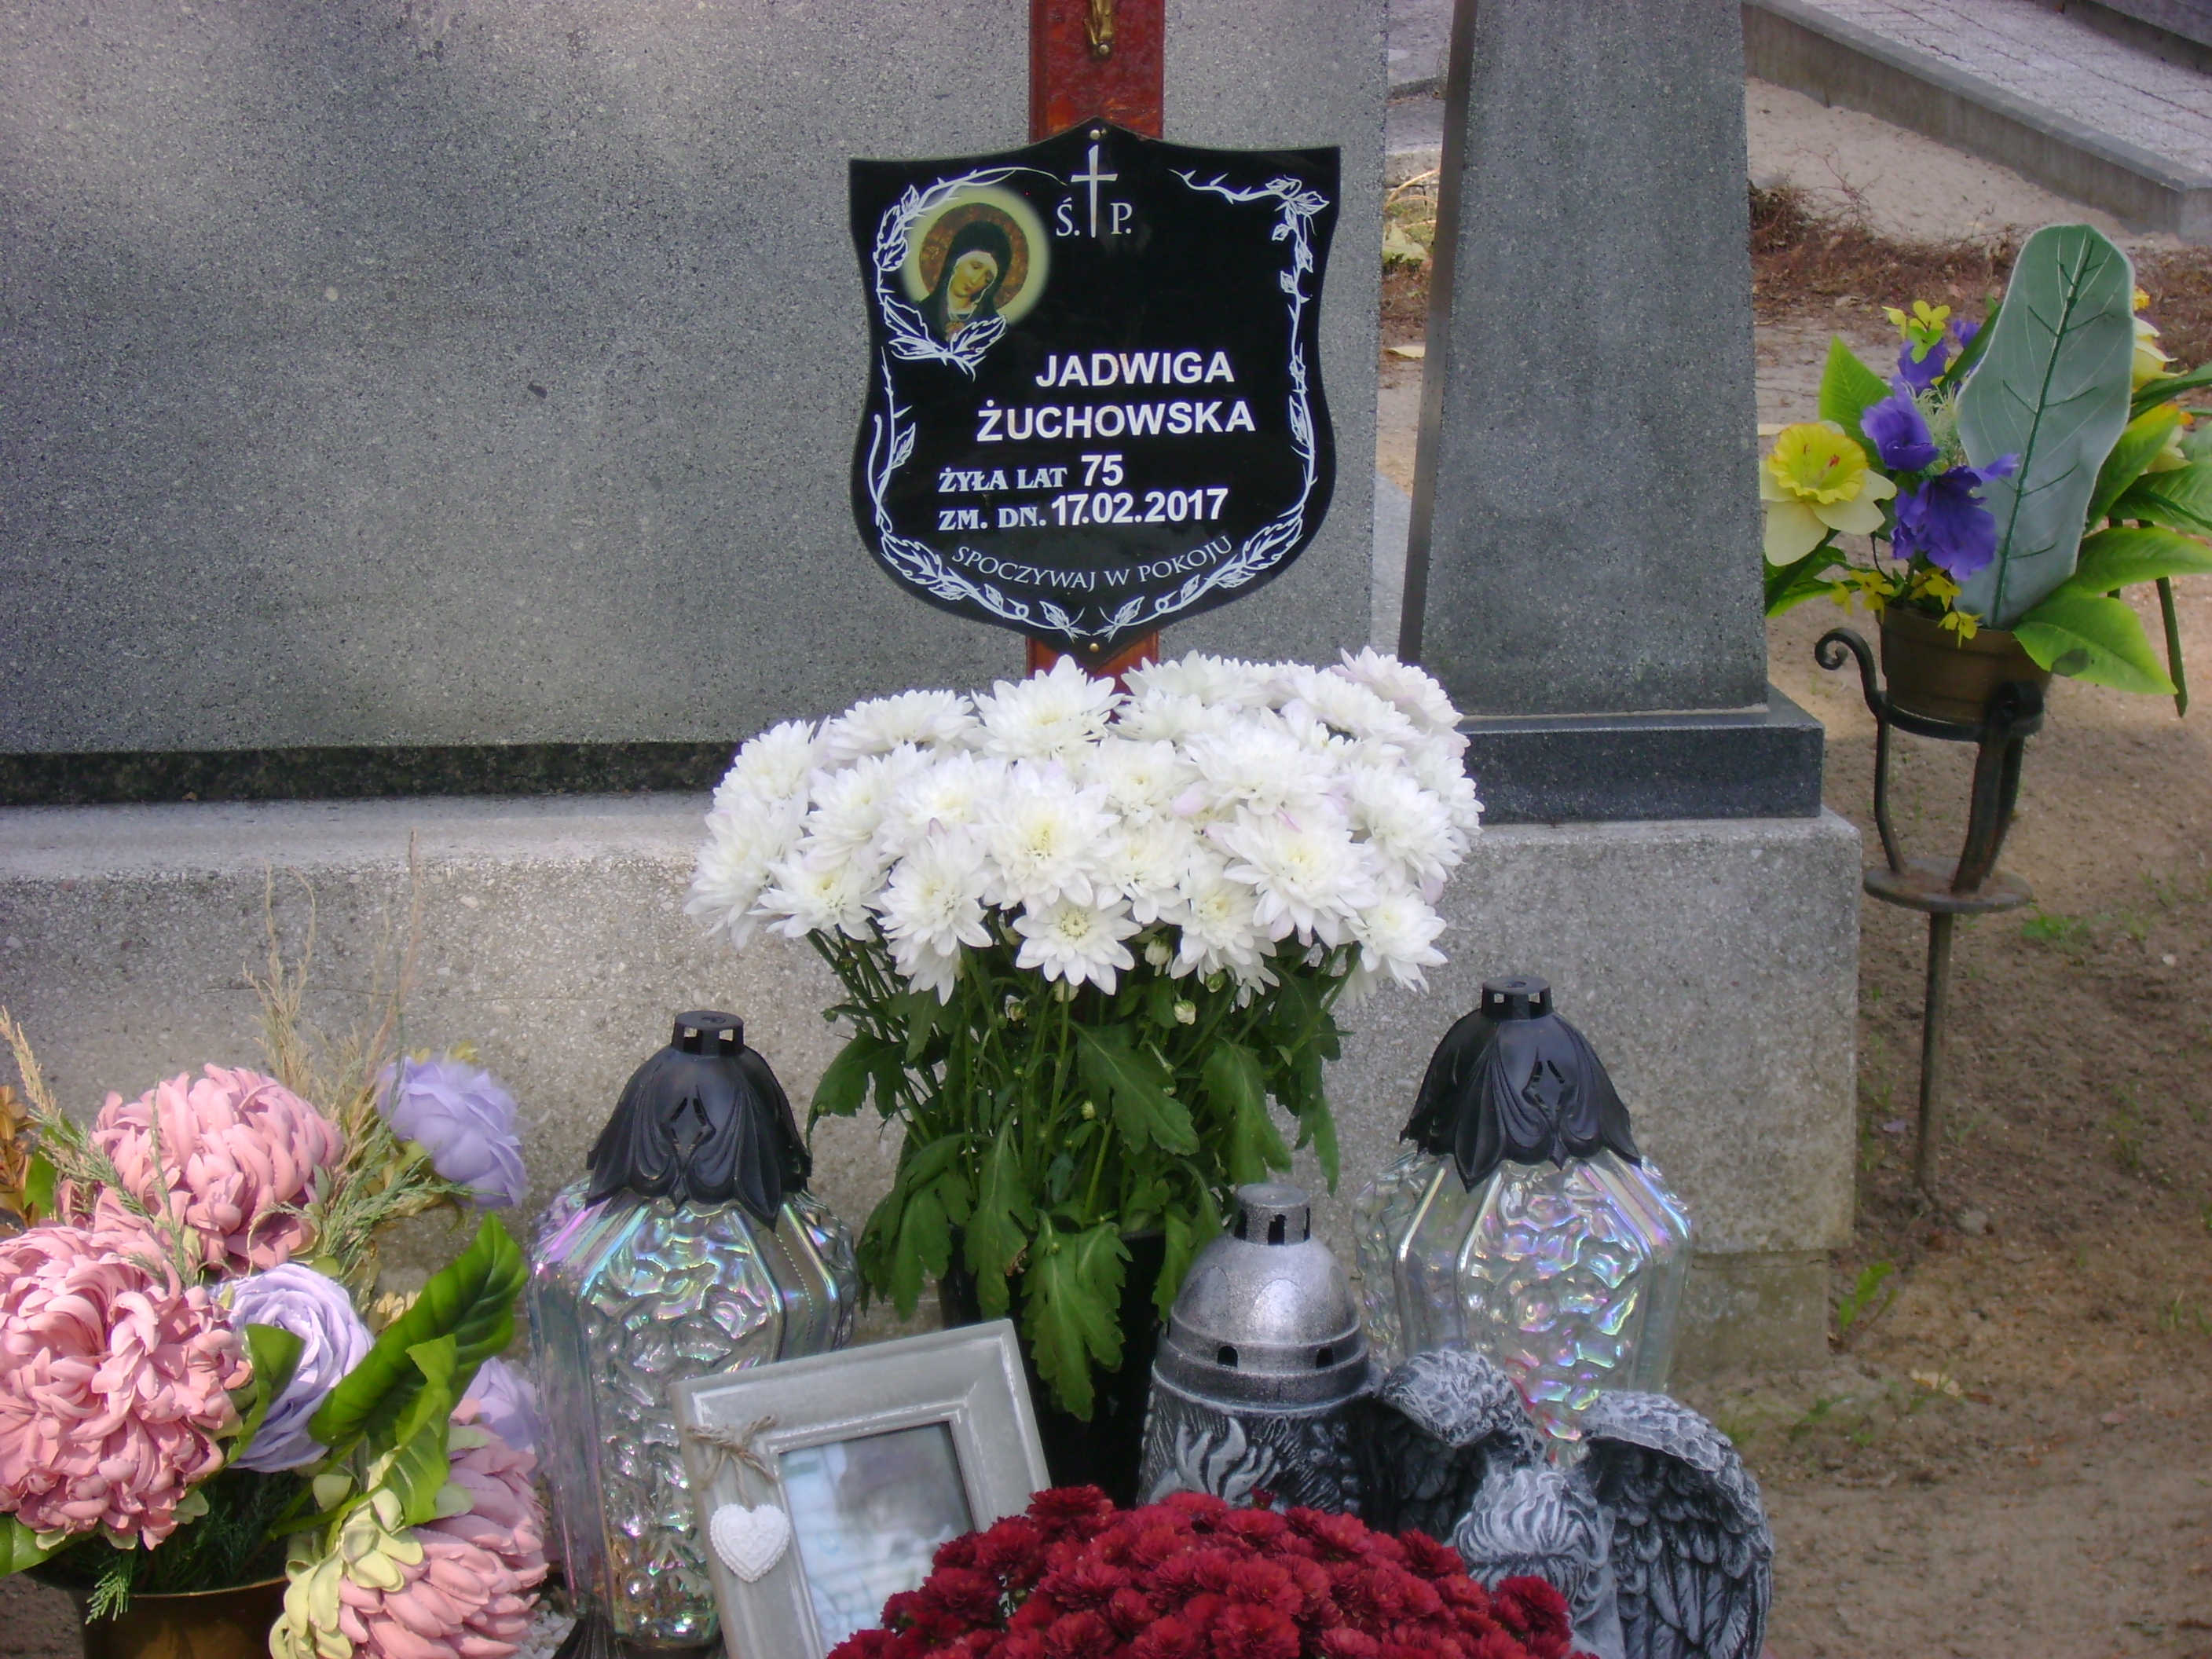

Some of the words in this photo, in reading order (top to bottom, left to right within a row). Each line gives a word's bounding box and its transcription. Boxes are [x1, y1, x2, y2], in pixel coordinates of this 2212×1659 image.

[1056, 196, 1080, 236] Ś.
[1110, 202, 1133, 235] P.
[1035, 351, 1235, 387] JADWIGA
[976, 399, 1256, 442] ŻUCHOWSKA
[938, 467, 1009, 493] ŻYŁA
[1016, 467, 1068, 489] LAT
[1081, 454, 1124, 487] 75
[938, 509, 988, 531] ZM.
[998, 507, 1047, 528] DN.
[1051, 488, 1229, 526] 17.02.2017
[951, 546, 1097, 593] SPOCZYWAJ
[1104, 568, 1131, 587] W
[1138, 535, 1232, 582] POKOJU
